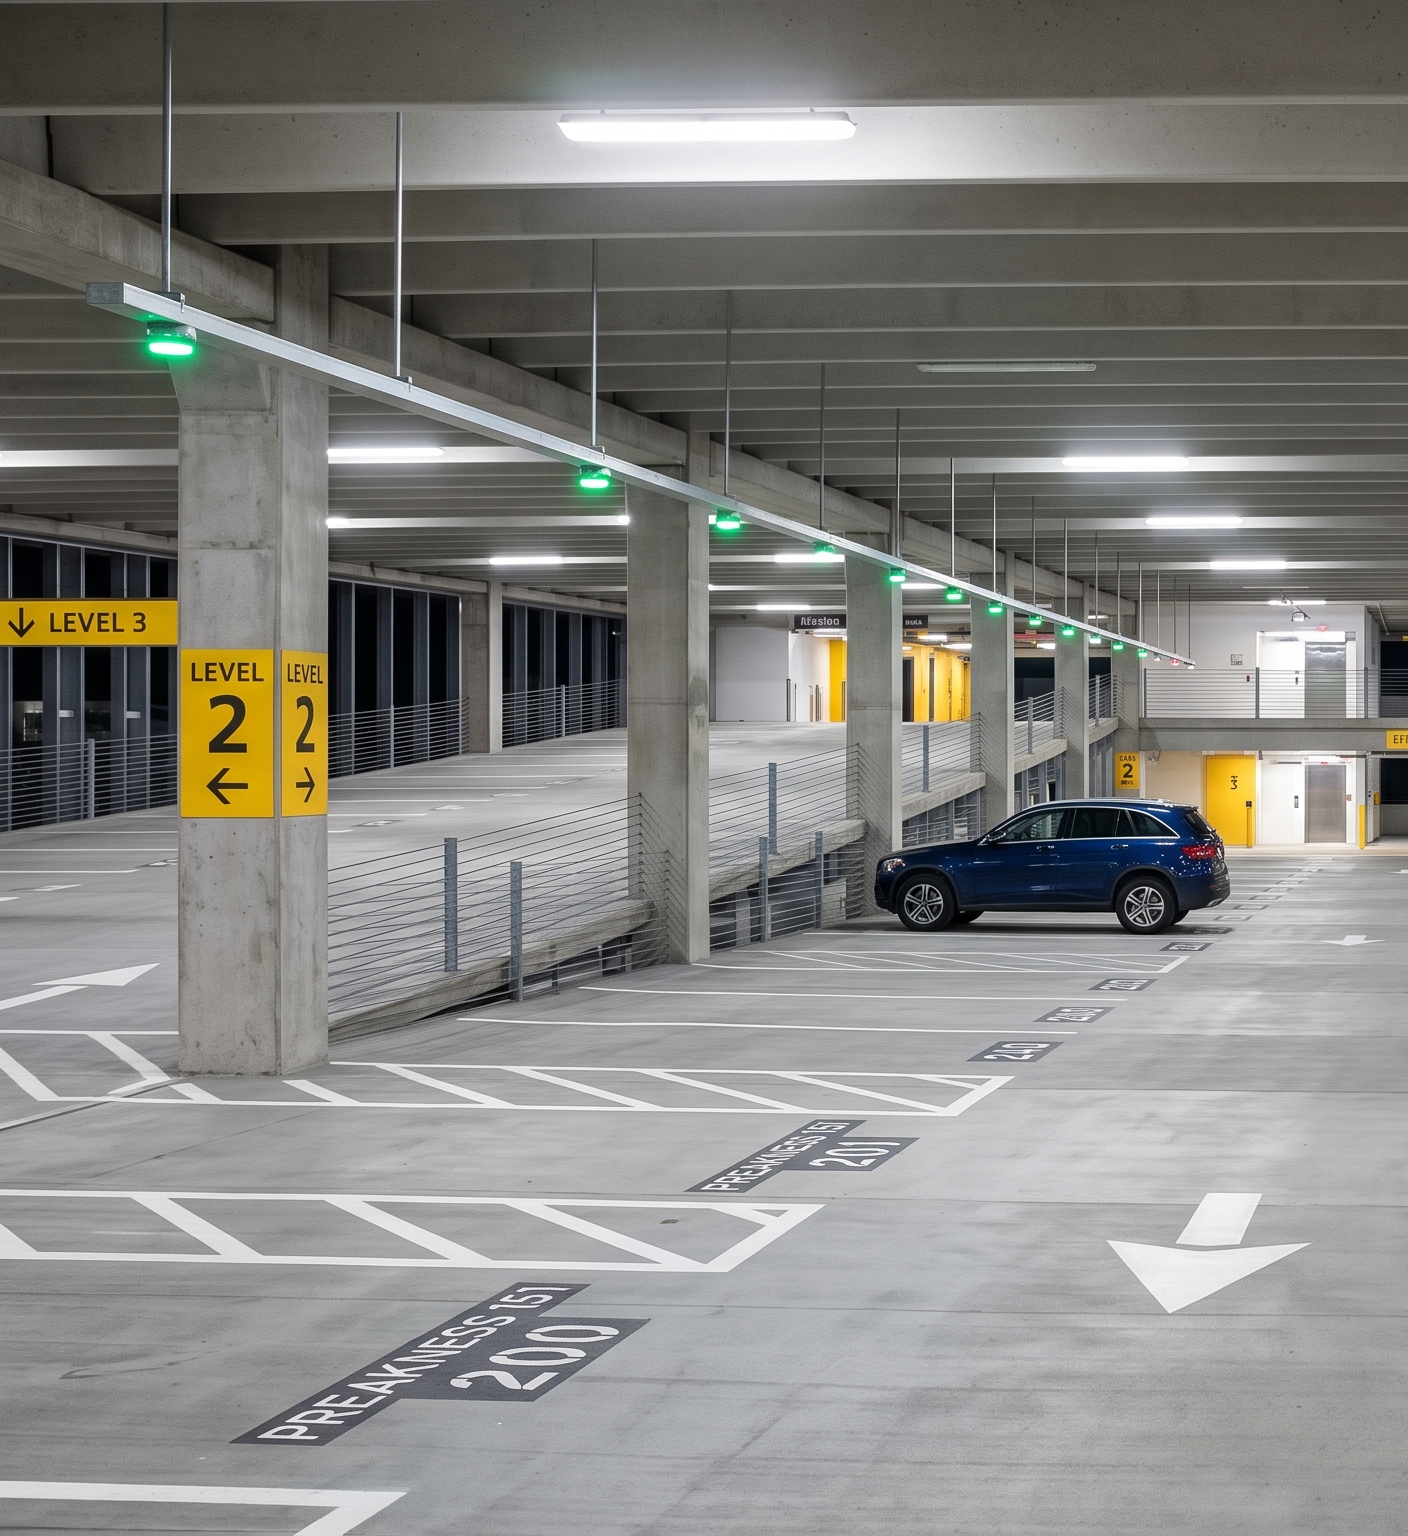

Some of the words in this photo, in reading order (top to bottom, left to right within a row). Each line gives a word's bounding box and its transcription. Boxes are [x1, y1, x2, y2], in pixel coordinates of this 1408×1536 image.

[50, 612, 124, 633] LEVEL
[133, 612, 147, 633] 3
[191, 662, 264, 682] LEVEL
[287, 663, 324, 684] LEVEL
[208, 694, 248, 753] 2
[295, 695, 315, 753] 2
[1122, 763, 1133, 778] 2
[700, 1135, 827, 1191] PREAKNESS
[808, 1141, 900, 1167] 201
[257, 1315, 517, 1440] PREAKNESS
[489, 1287, 571, 1310] 151
[450, 1324, 619, 1391] 200
